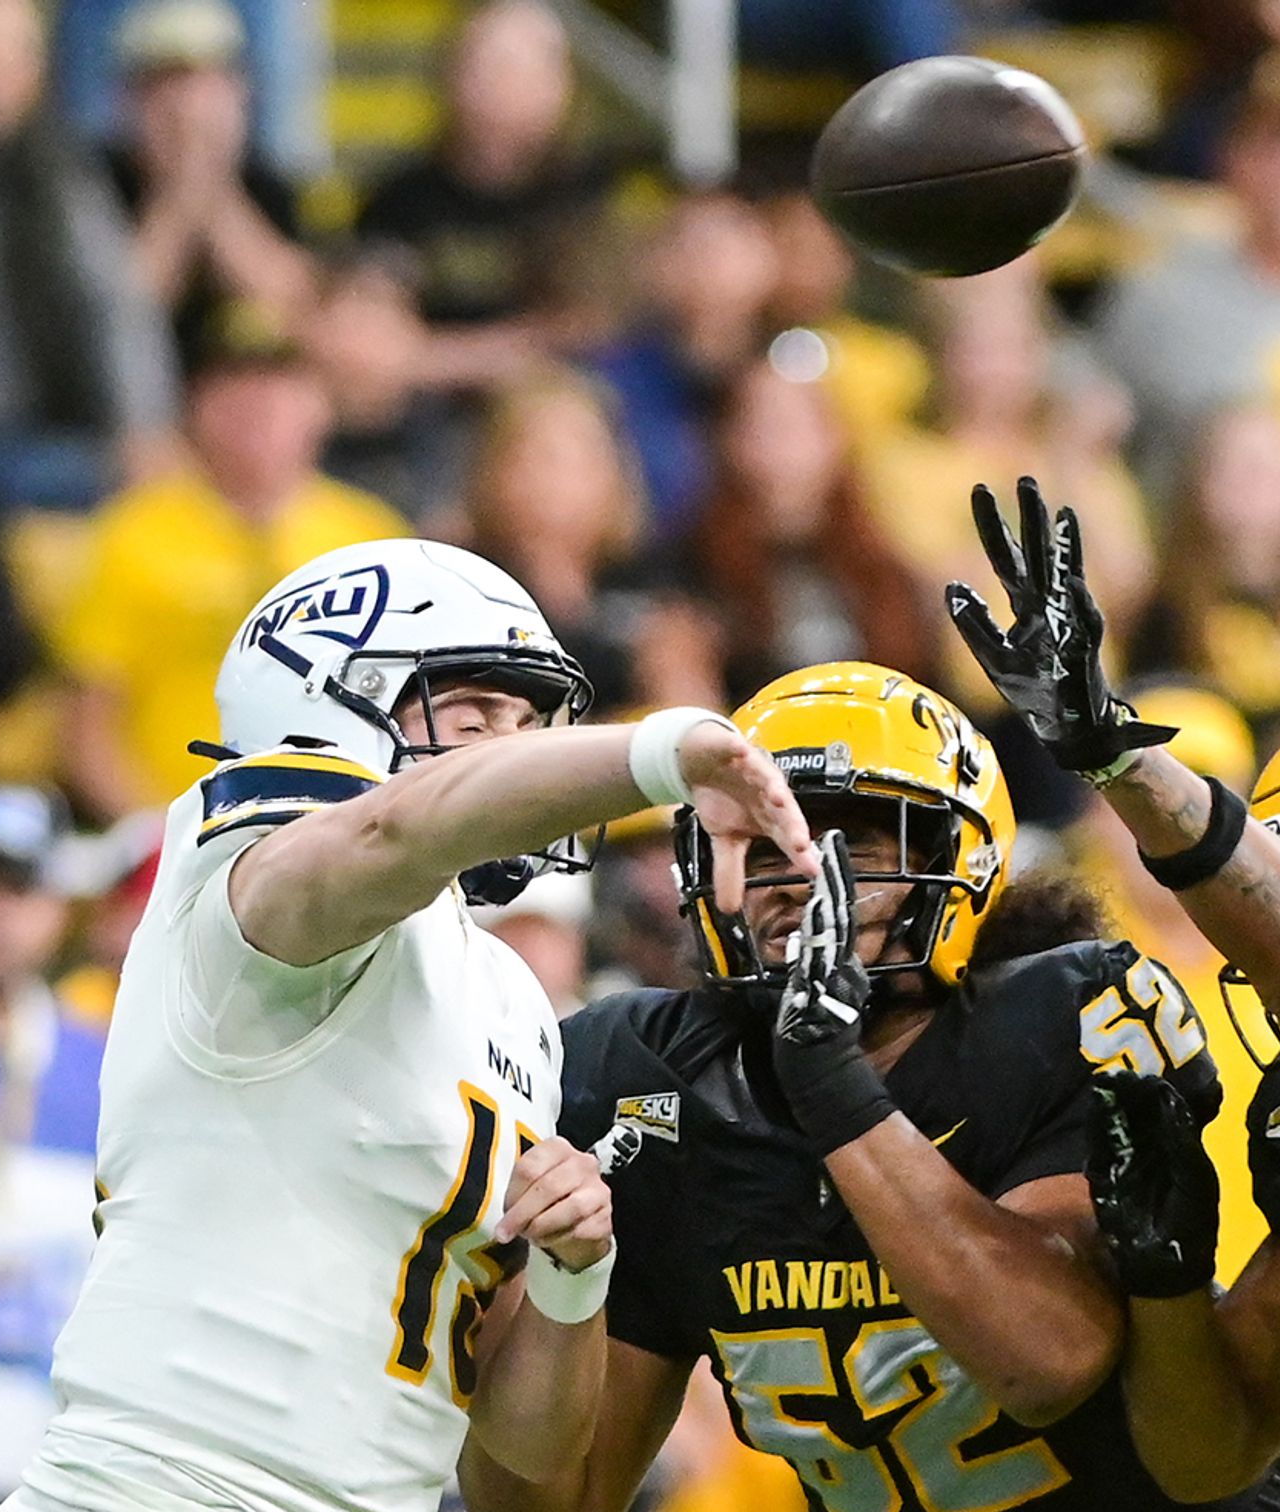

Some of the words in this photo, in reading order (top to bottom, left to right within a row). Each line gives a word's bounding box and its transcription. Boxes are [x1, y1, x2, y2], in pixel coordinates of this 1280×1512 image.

[248, 586, 368, 648] NAU
[774, 754, 825, 770] IDAHO
[1079, 956, 1206, 1077] 52
[487, 1038, 533, 1103] NAU
[722, 1259, 900, 1314] VANDAL
